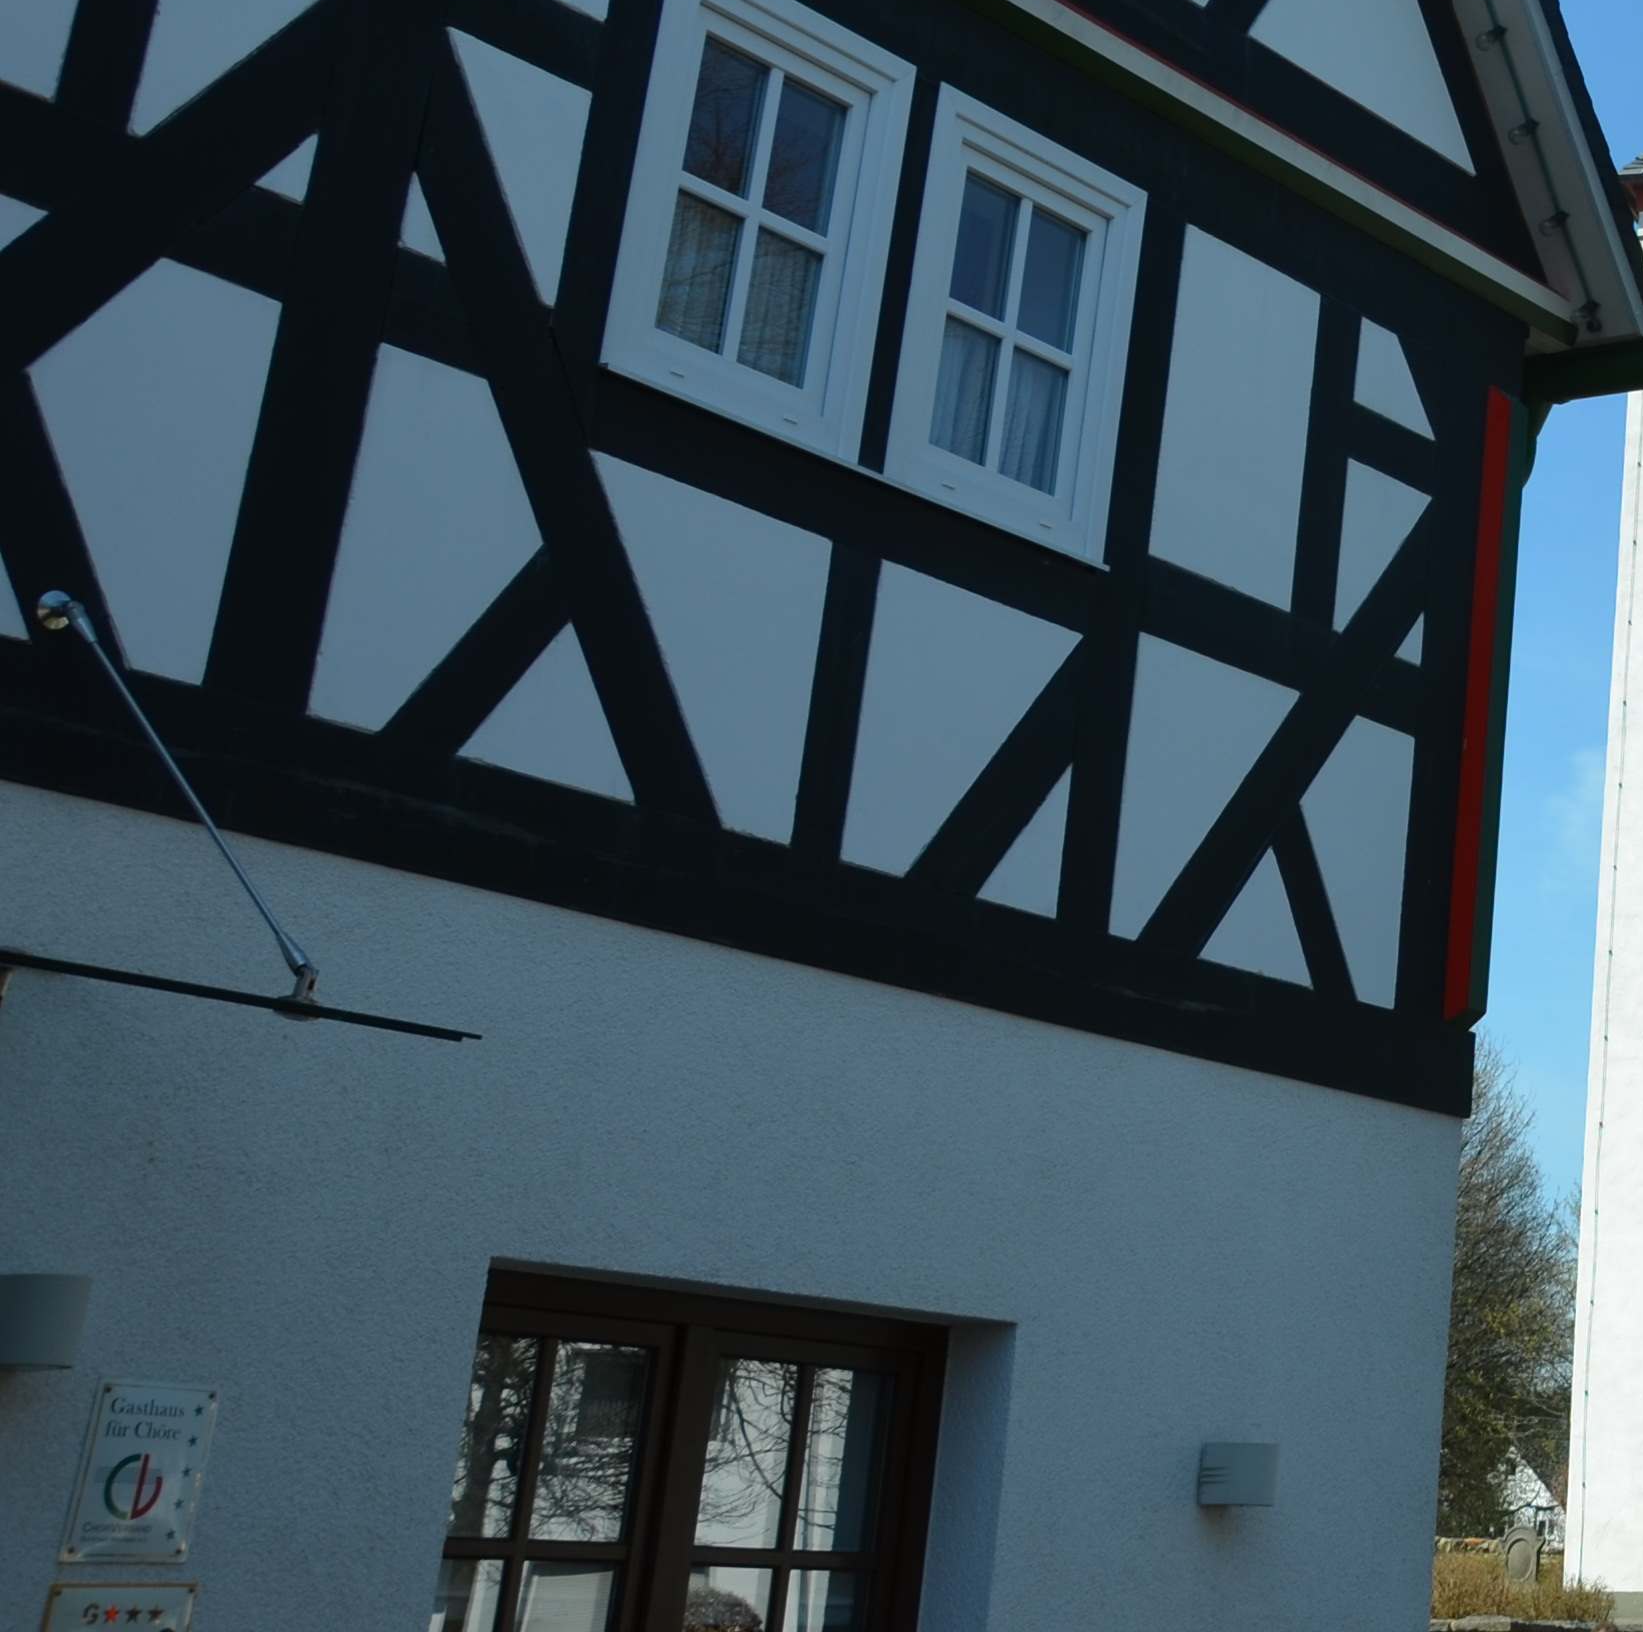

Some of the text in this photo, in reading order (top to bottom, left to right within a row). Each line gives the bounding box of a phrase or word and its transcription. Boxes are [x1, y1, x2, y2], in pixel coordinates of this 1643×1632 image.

[111, 1397, 185, 1418] Gasthaus
[104, 1419, 182, 1441] für Chöre
